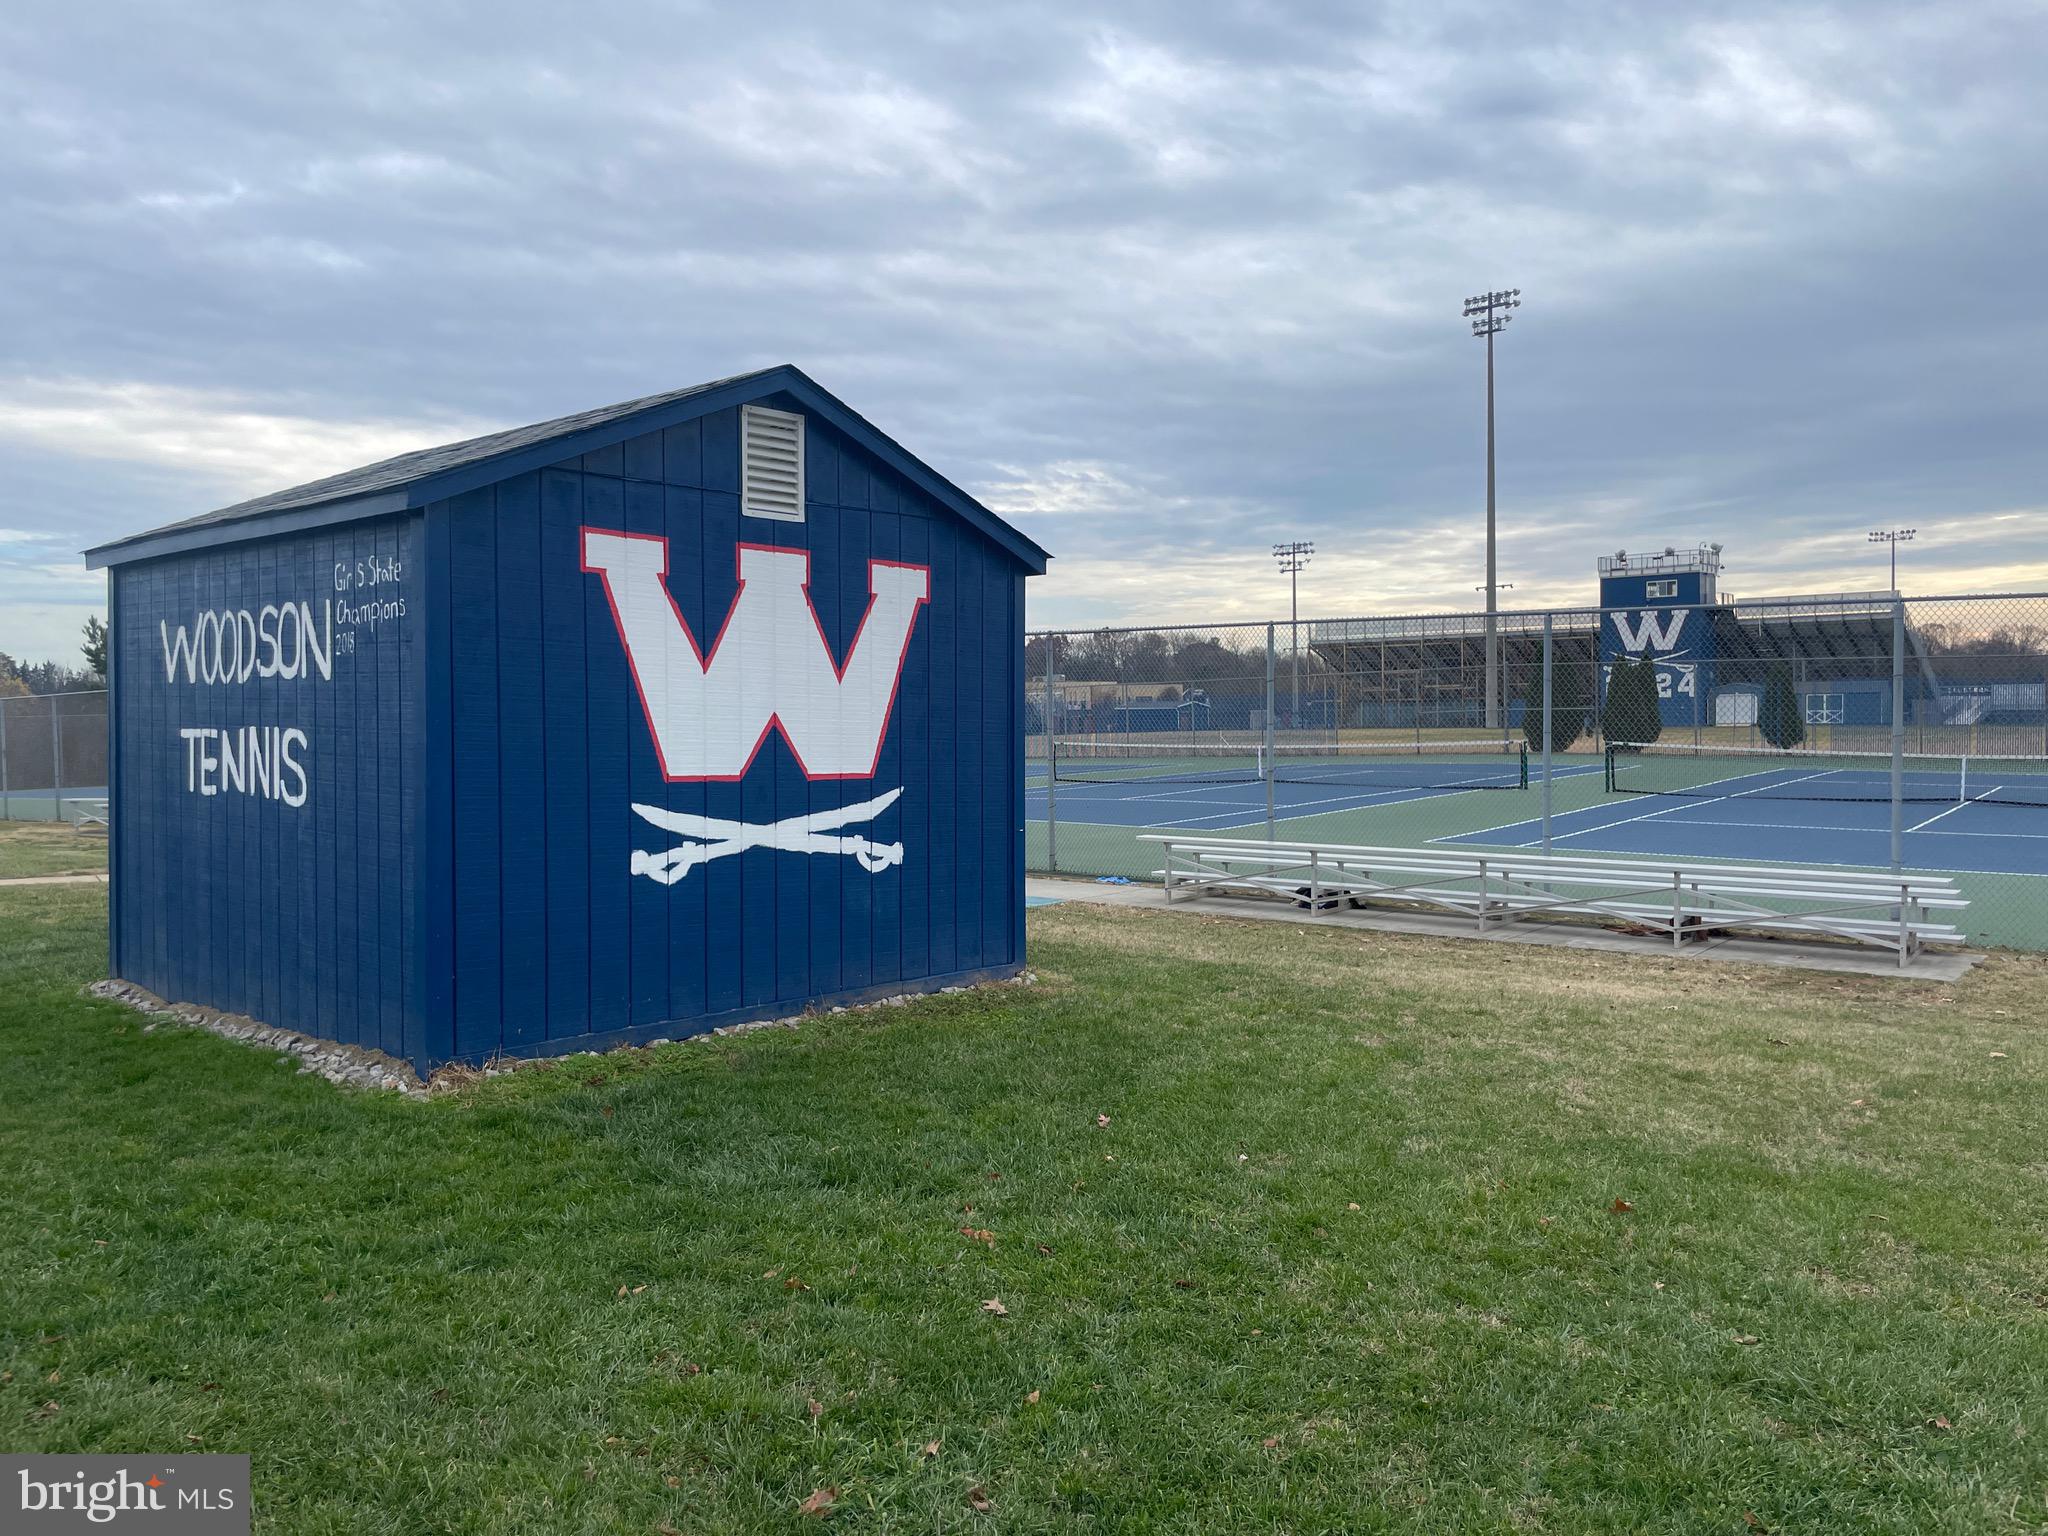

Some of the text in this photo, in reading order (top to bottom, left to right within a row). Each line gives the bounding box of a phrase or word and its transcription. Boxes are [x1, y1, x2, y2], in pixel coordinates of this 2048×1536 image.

[369, 555, 402, 586] State
[161, 599, 332, 685] WOODSON
[337, 598, 406, 633] Champions
[1610, 609, 1690, 652] W
[579, 525, 930, 783] W
[180, 726, 308, 808] TENNIS
